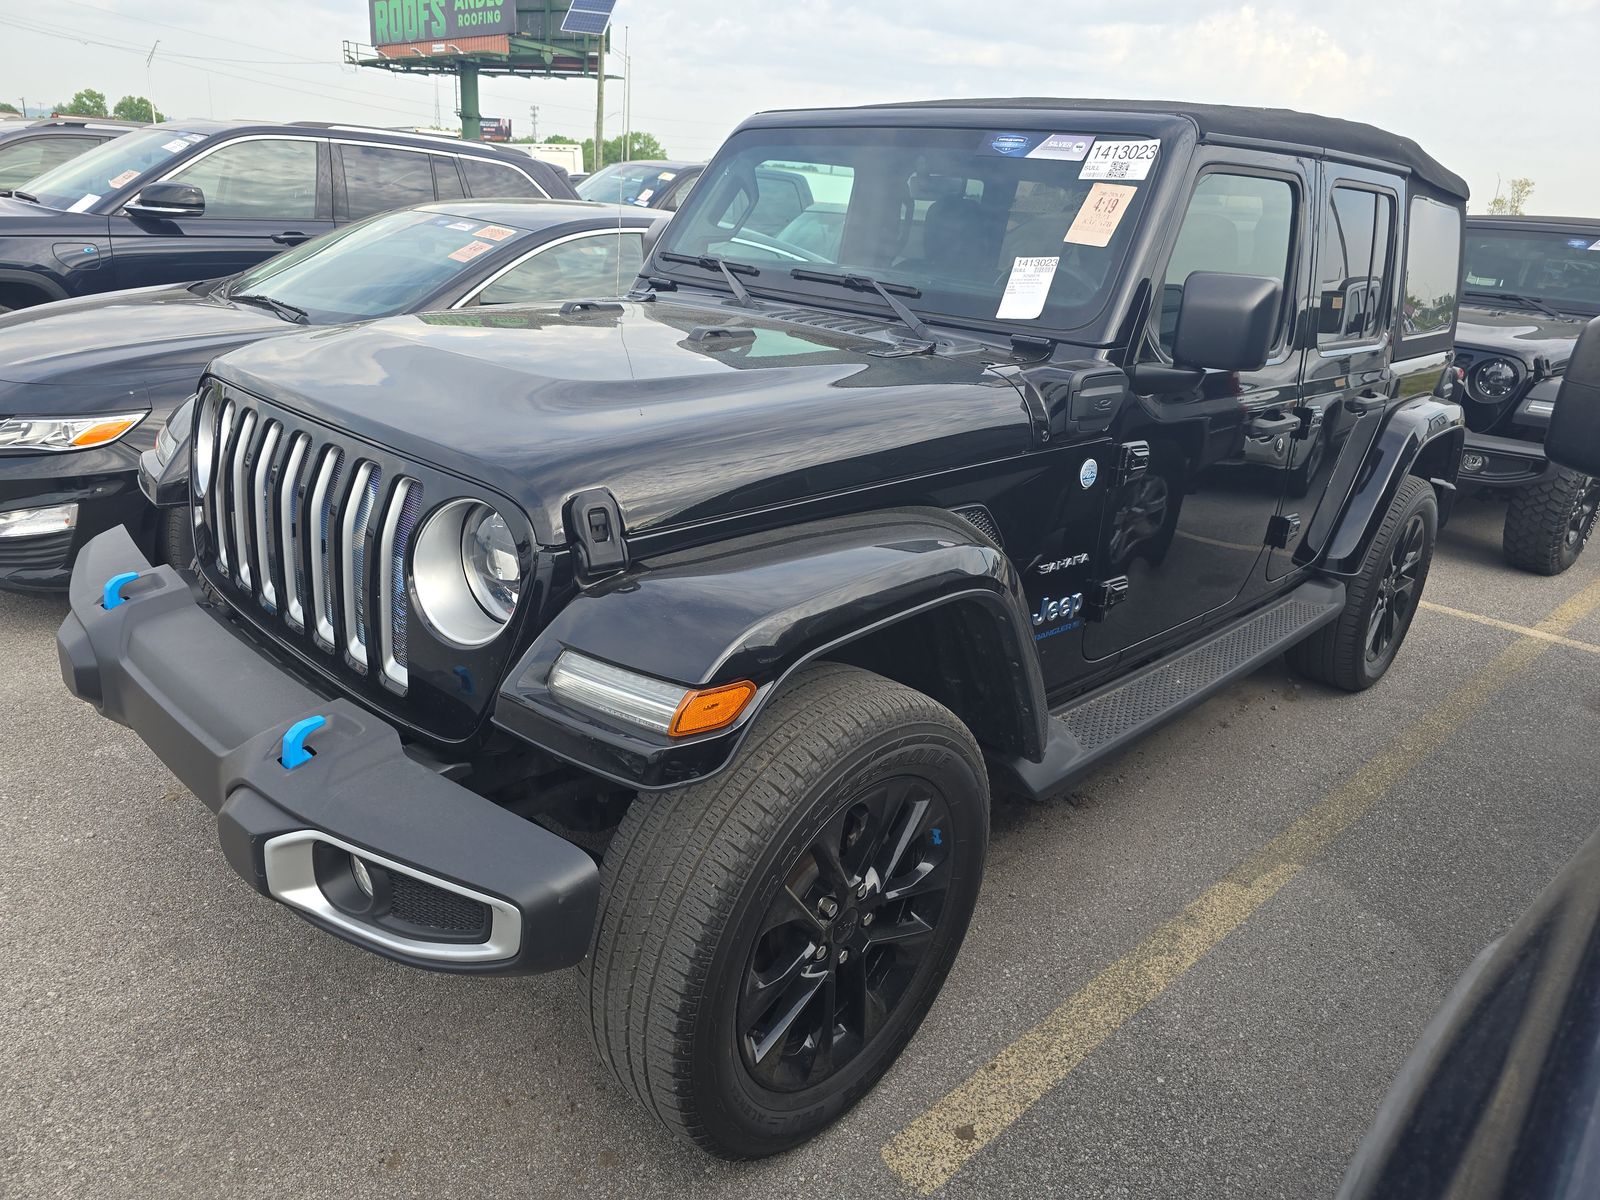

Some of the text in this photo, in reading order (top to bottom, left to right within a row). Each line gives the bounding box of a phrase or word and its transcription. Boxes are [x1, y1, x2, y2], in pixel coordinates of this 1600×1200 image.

[374, 0, 447, 43] ROOFS
[458, 10, 501, 27] ROOFING
[1094, 144, 1158, 159] 1413023
[1017, 258, 1059, 267] 1413023
[1037, 552, 1090, 574] SAHARA
[1031, 592, 1083, 626] Jeep
